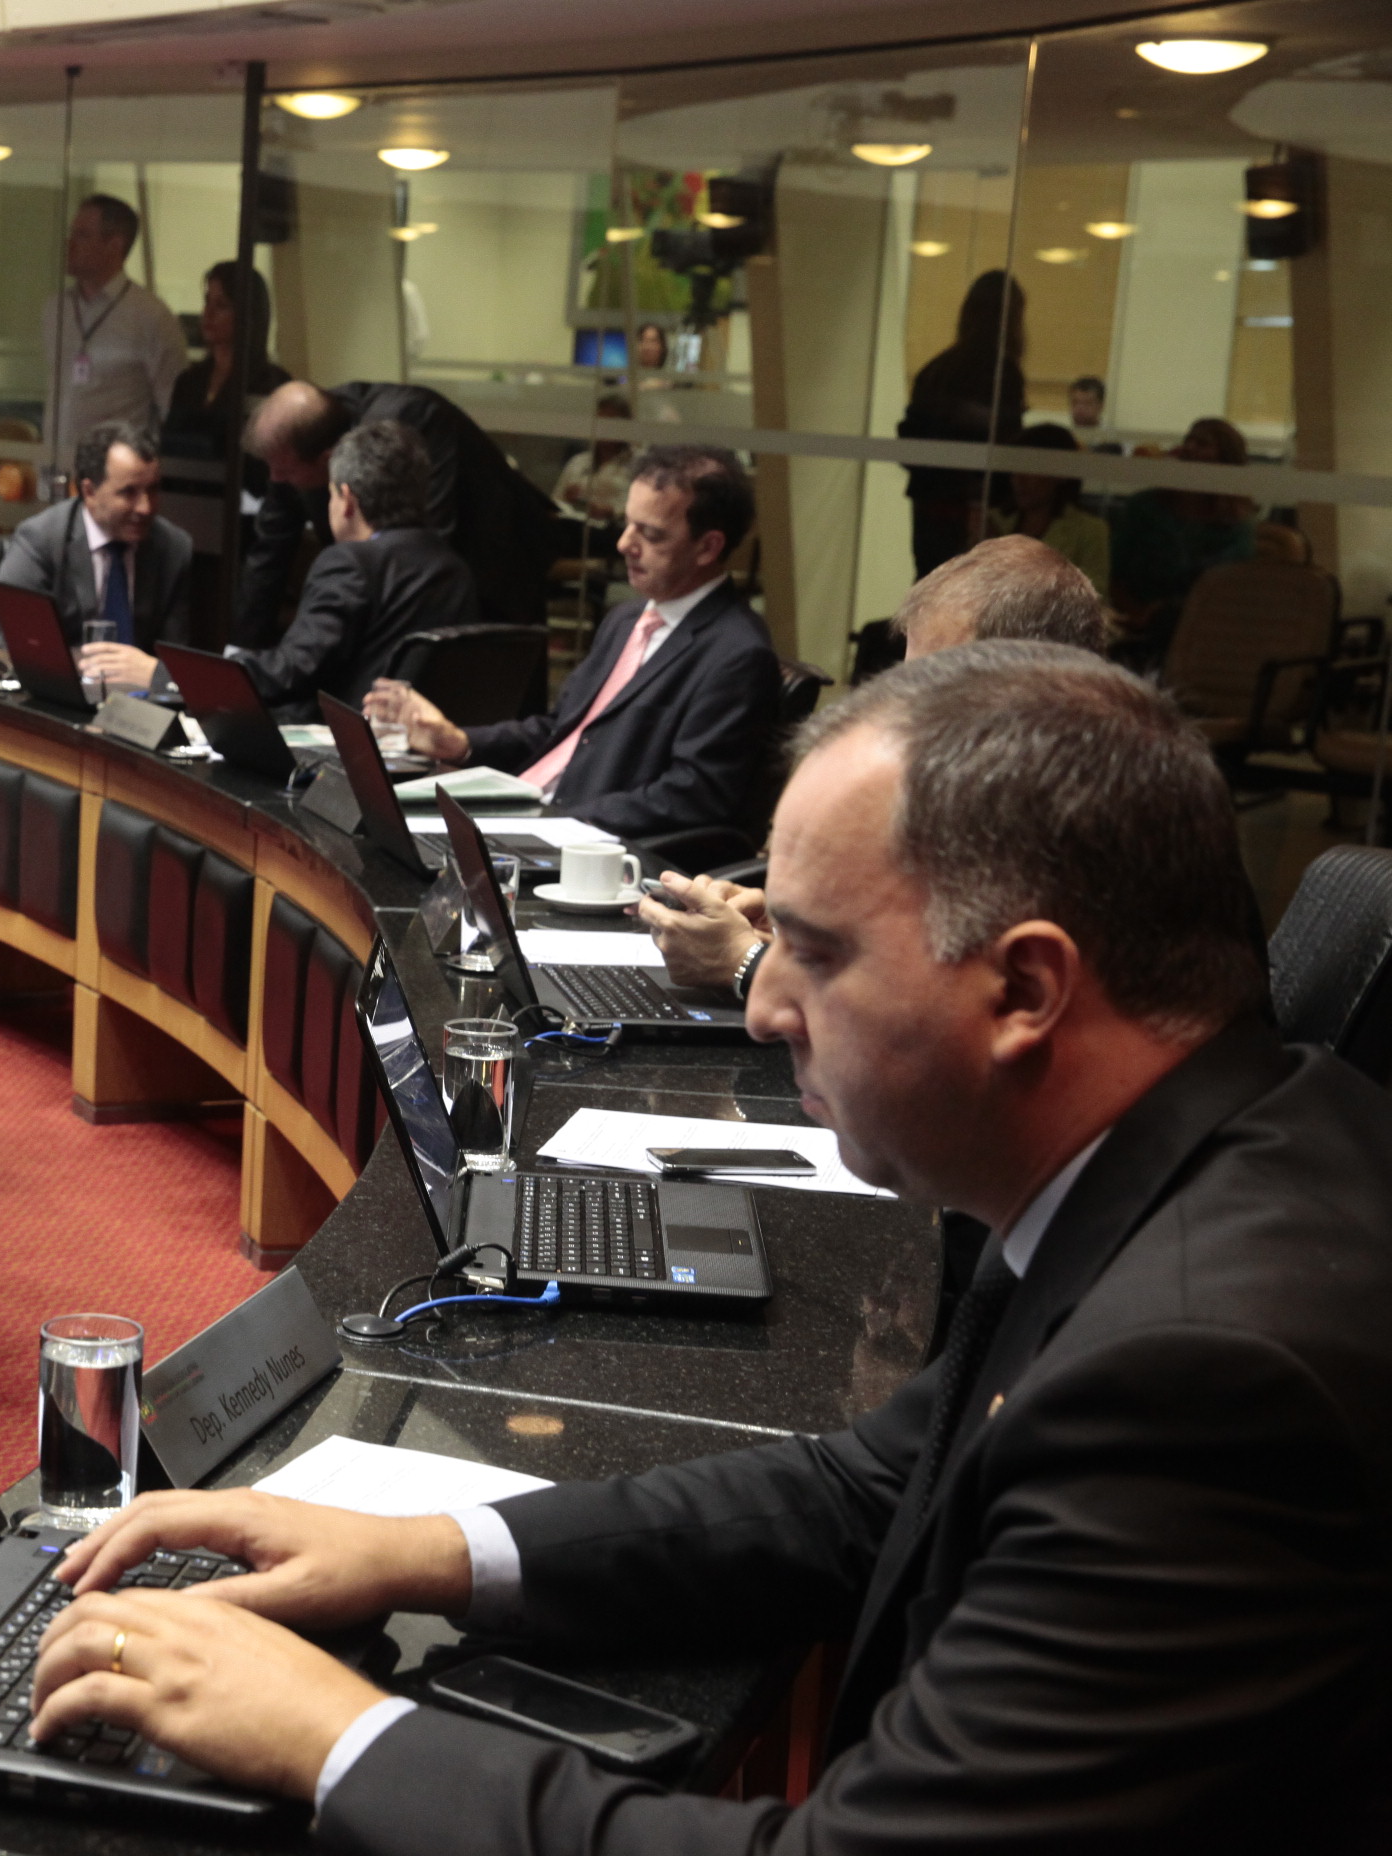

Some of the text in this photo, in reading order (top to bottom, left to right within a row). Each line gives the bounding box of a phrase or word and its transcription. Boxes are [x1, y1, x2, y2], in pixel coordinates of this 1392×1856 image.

[190, 1411, 226, 1445] Dep.
[218, 1367, 275, 1422] Kennedy
[265, 1345, 306, 1385] Nunes
